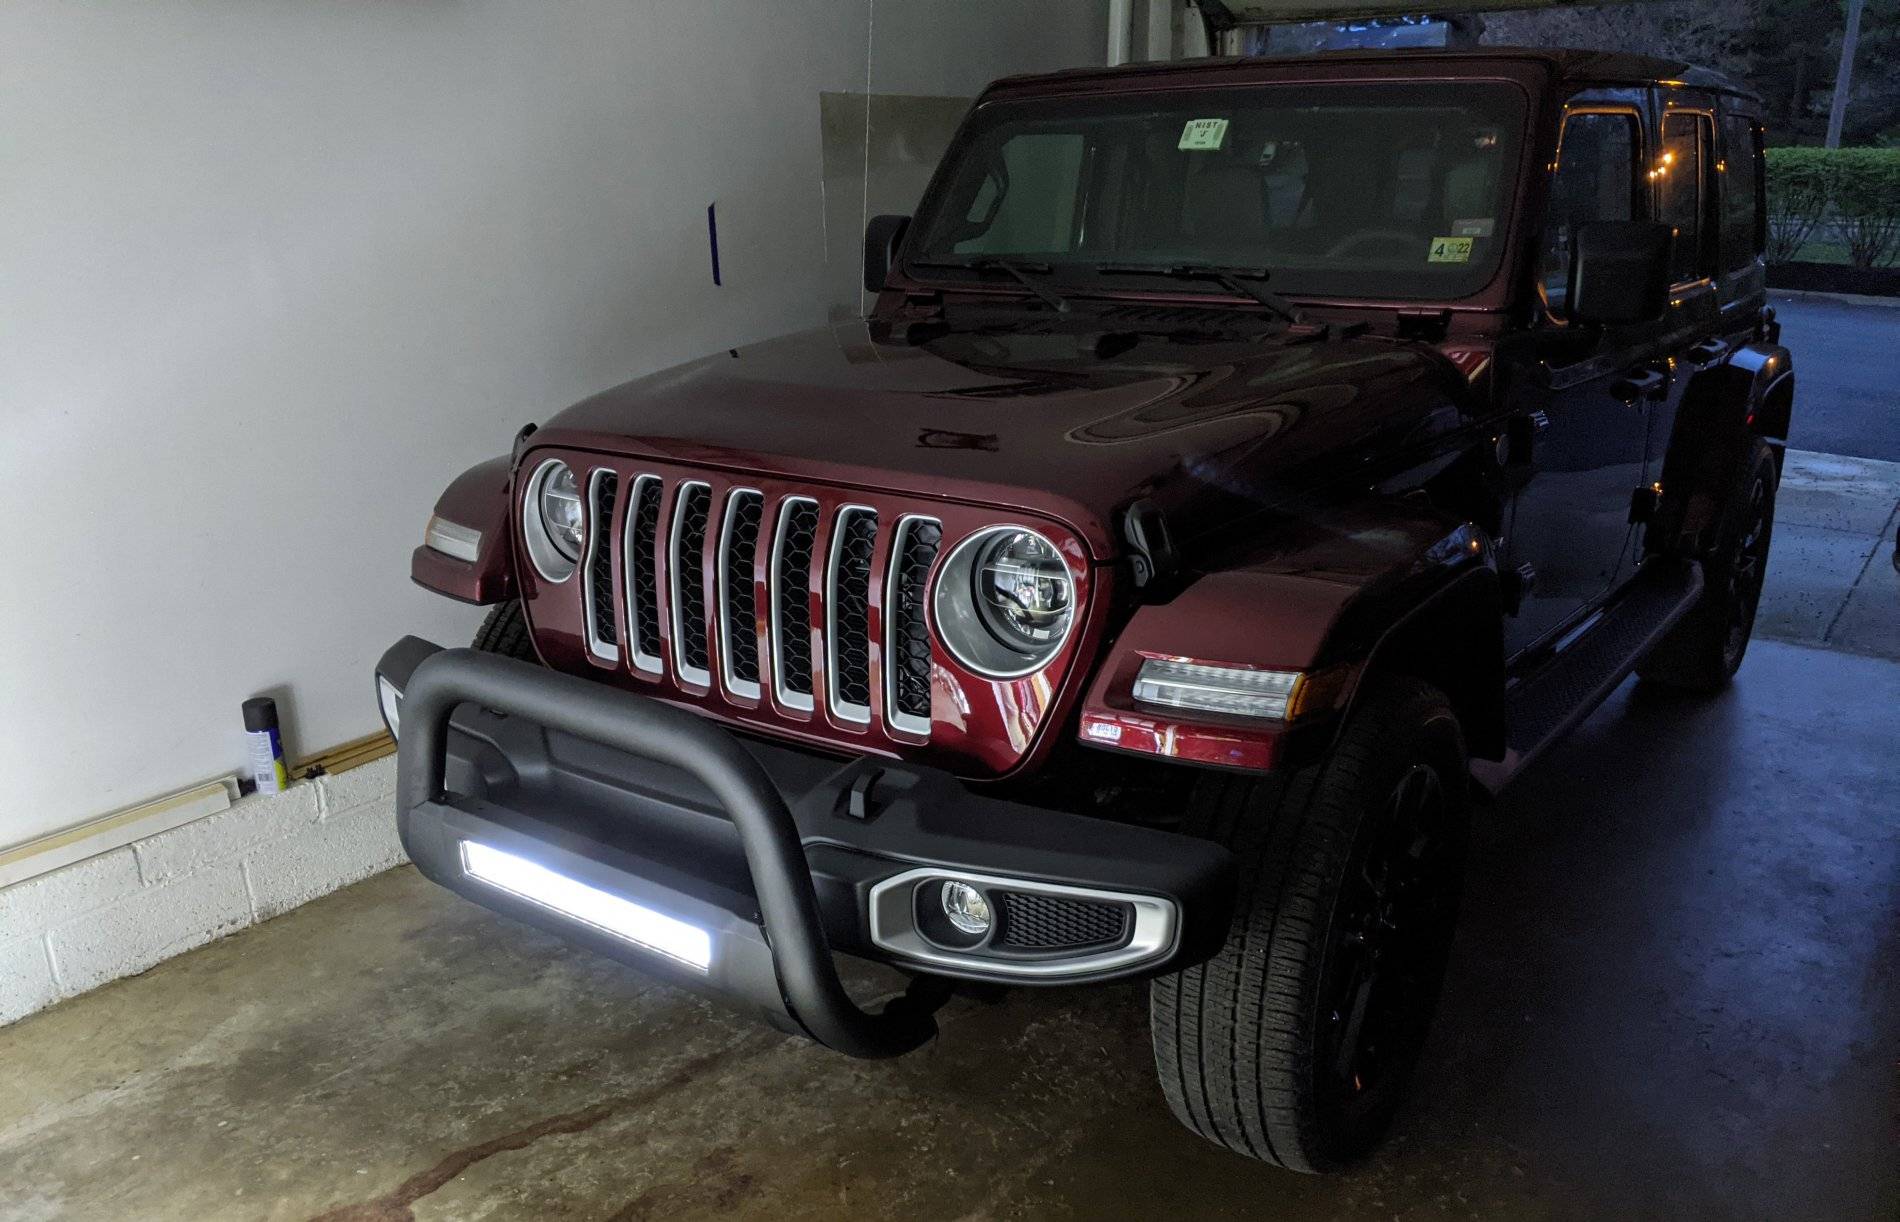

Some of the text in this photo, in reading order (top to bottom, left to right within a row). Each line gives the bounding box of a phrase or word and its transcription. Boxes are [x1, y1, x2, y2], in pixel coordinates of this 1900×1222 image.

[1195, 121, 1218, 129] NIST
[1434, 243, 1470, 257] 4 22
